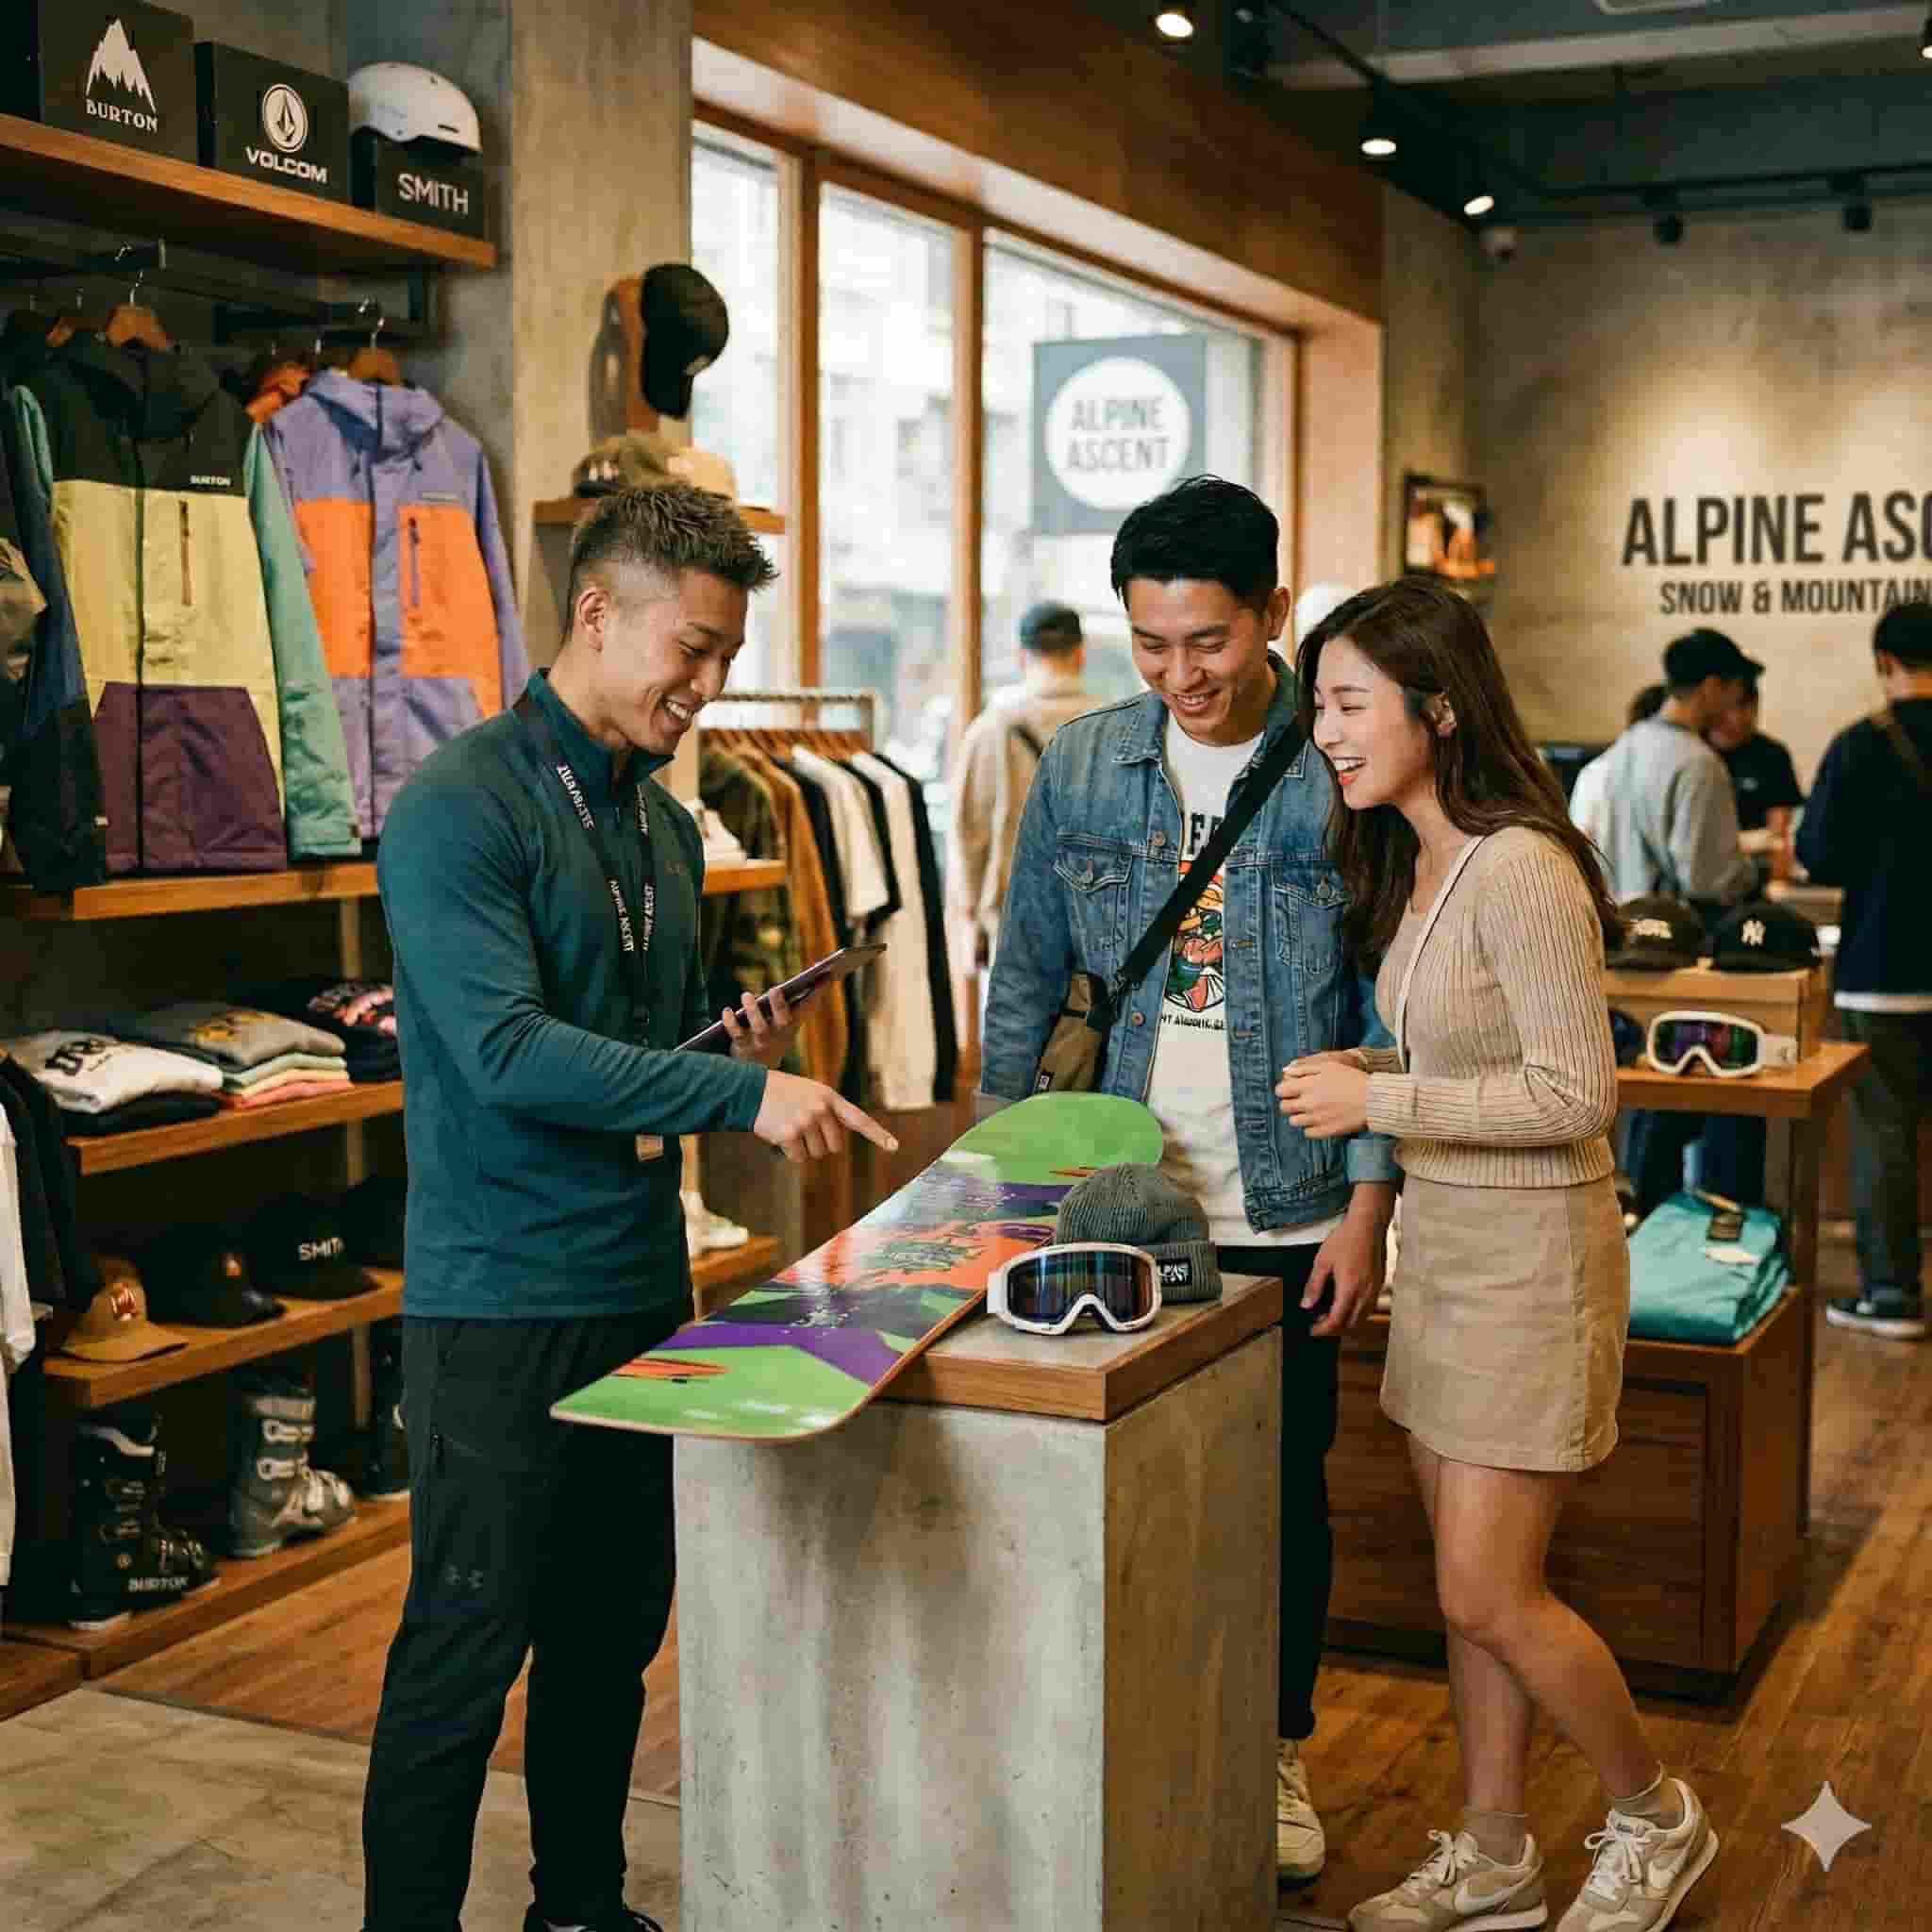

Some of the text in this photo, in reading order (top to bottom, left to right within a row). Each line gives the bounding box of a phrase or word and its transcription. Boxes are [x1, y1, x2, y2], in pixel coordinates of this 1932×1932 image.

[86, 99, 158, 133] BURTON
[245, 146, 328, 184] VOLCOM
[397, 173, 469, 216] SMITH
[1072, 400, 1165, 431] ALPINE
[1066, 437, 1170, 472] ASCENT
[190, 475, 231, 487] BURTON
[1622, 493, 1825, 566] ALPINE
[1660, 580, 1742, 614] SNOW
[1753, 581, 1771, 613] &
